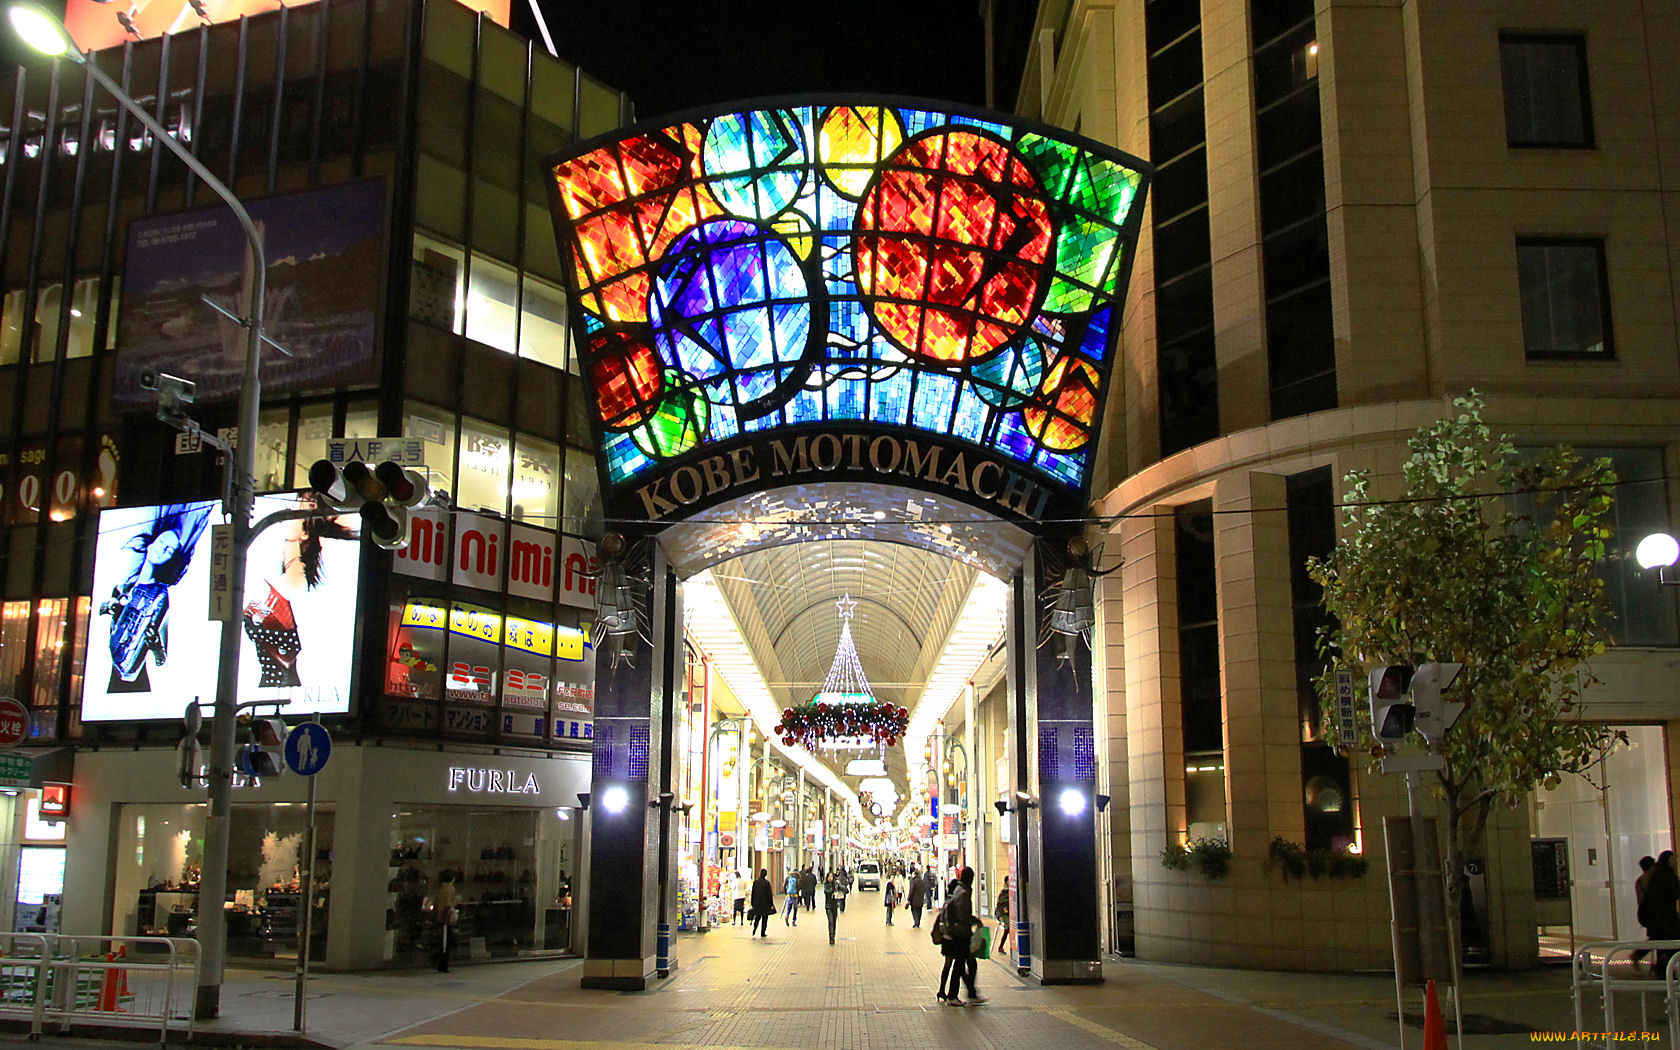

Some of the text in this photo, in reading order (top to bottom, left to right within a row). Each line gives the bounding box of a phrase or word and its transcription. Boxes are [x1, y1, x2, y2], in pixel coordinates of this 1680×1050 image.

[635, 432, 1053, 520] KOBE MOTOMACHI
[452, 662, 544, 691] ミニ ミニ
[448, 767, 541, 794] FURLA
